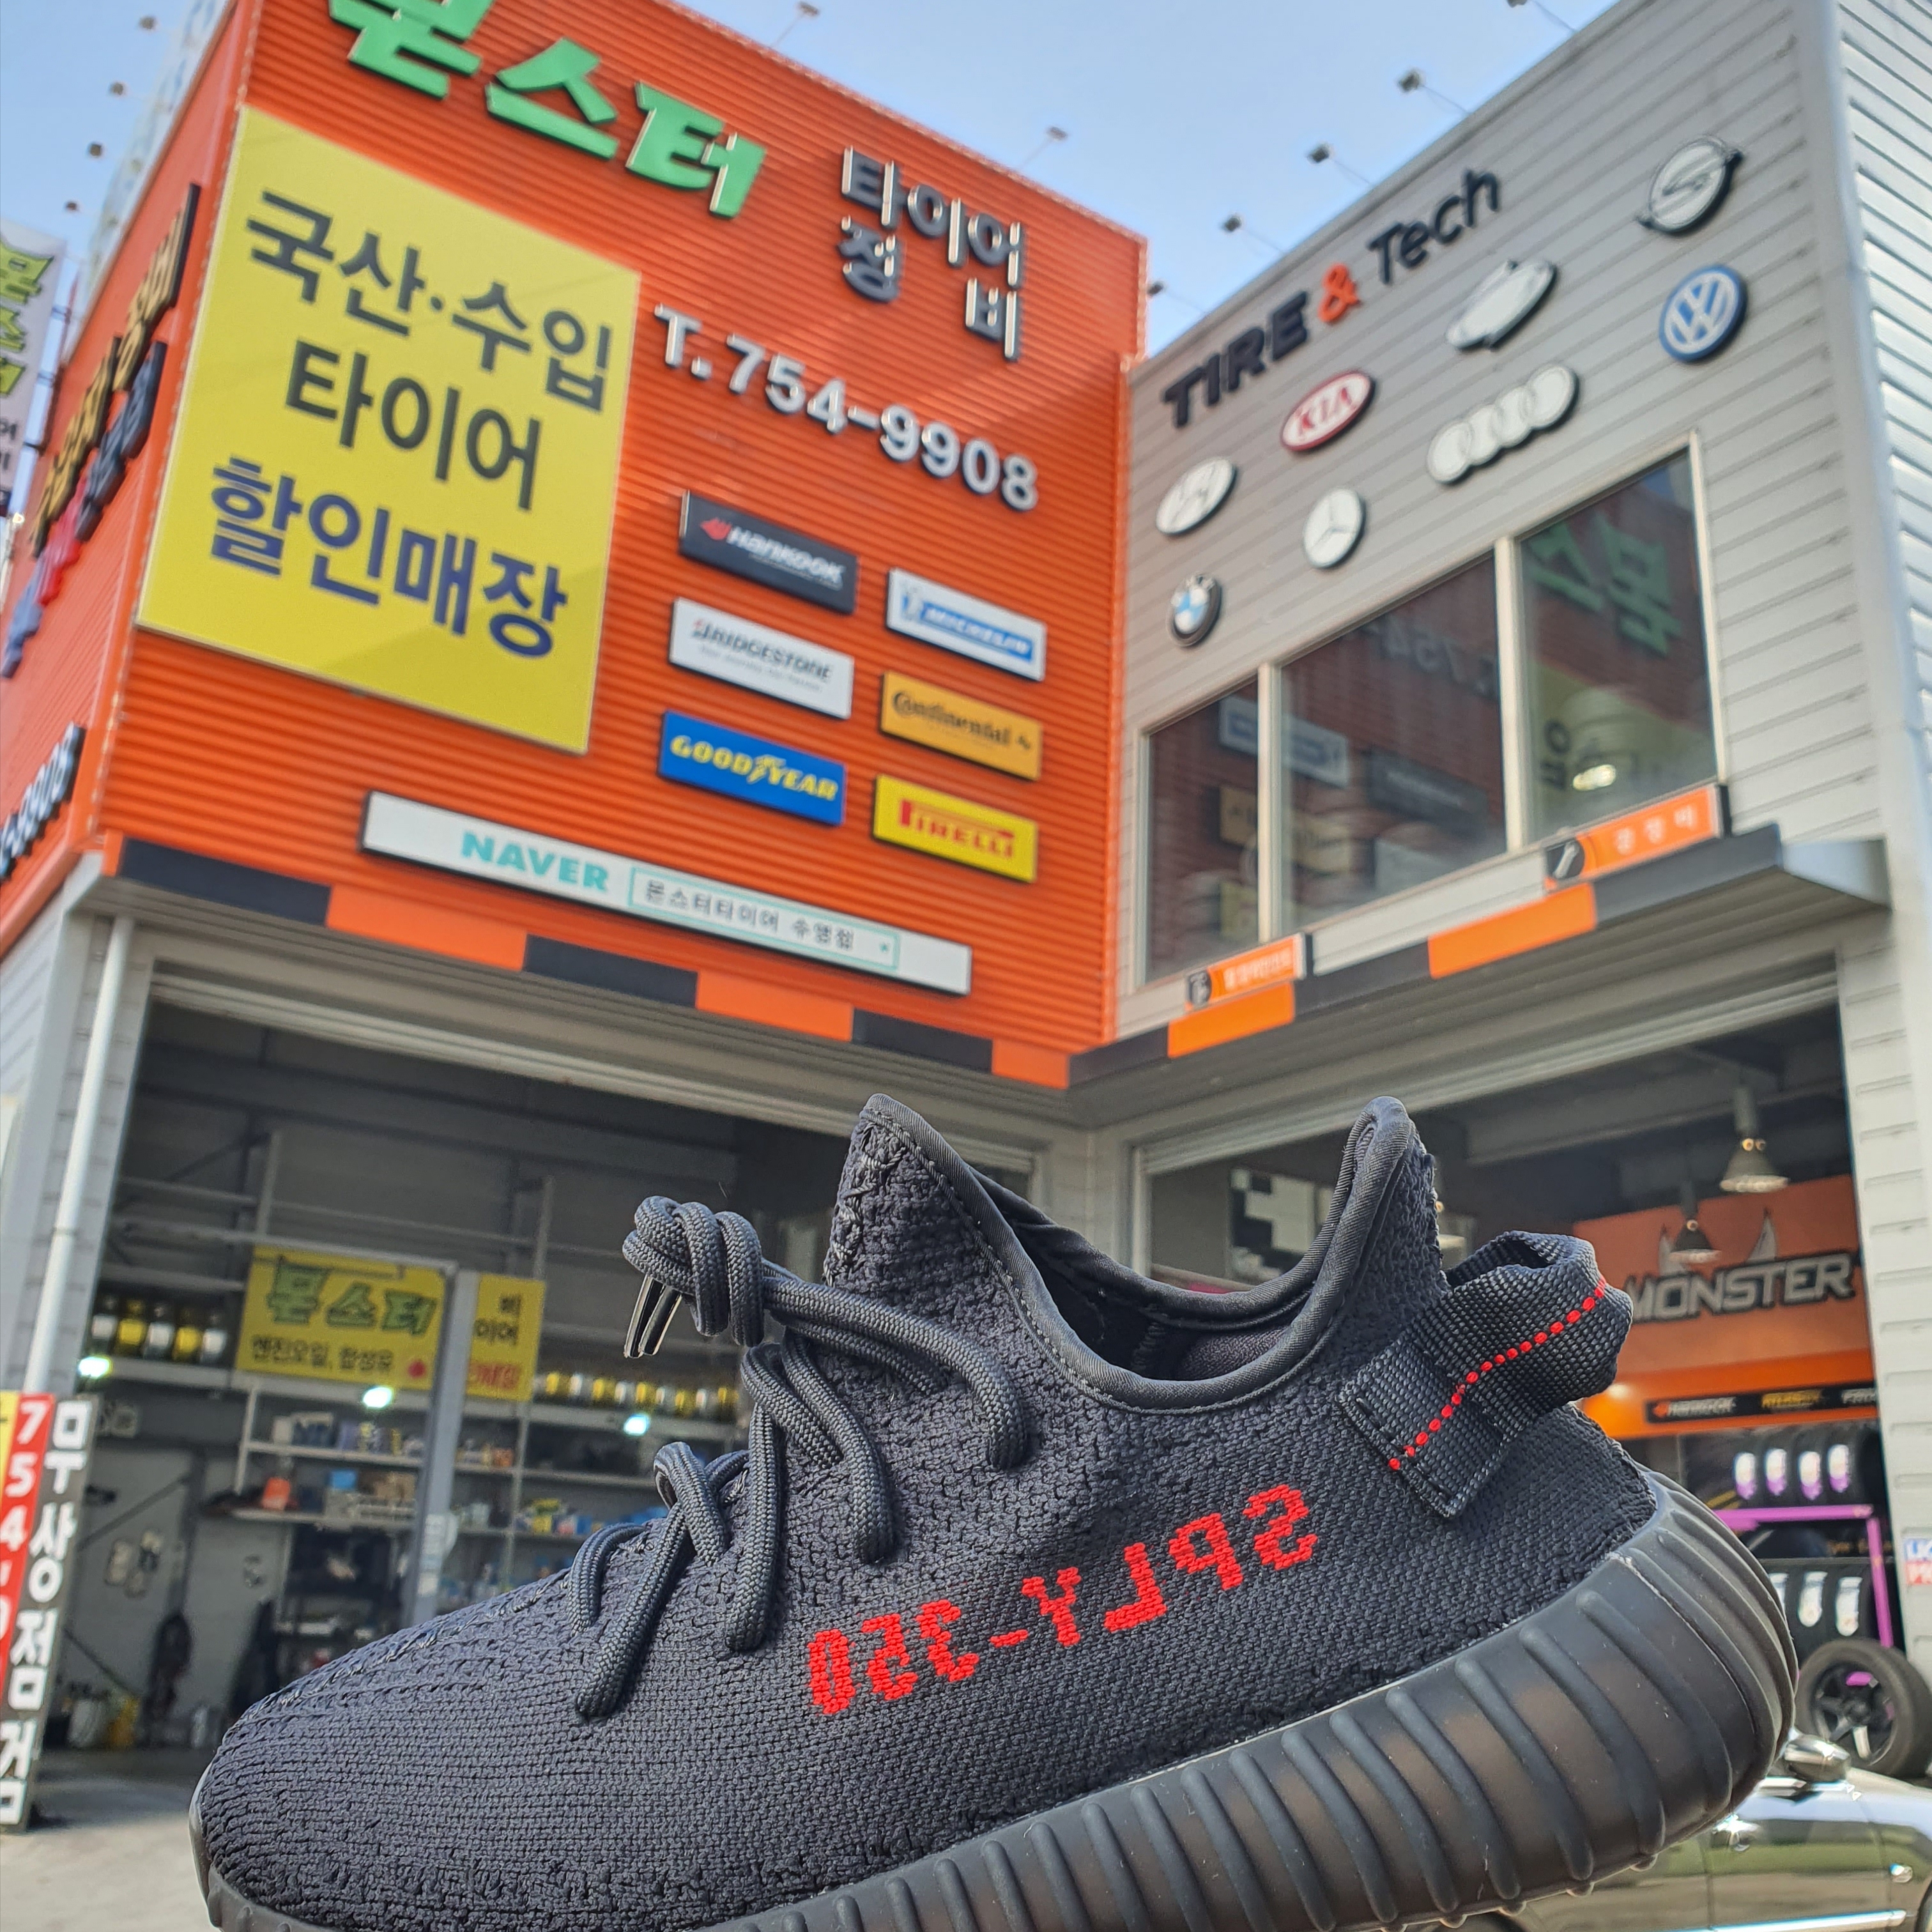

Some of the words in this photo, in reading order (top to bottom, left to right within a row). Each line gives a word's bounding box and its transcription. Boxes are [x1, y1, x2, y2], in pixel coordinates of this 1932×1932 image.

[840, 146, 1027, 288] 타이어
[246, 188, 614, 415] 국산·수입
[1162, 289, 1310, 428] TIRE
[1317, 261, 1361, 325] &
[1366, 168, 1503, 284] Tech
[285, 337, 543, 512] 타이어
[654, 302, 1038, 511] T.754-9908
[210, 455, 568, 661] 할인매장
[692, 620, 834, 680] BRIDGESTONE
[670, 735, 838, 801] GOODYEAR
[901, 800, 1015, 858] PIRELLI
[461, 829, 610, 893] NAVER
[266, 1262, 437, 1336] 몬스터
[1625, 1254, 1855, 1321] MONSTER
[0, 1400, 92, 1825] 무상점검
